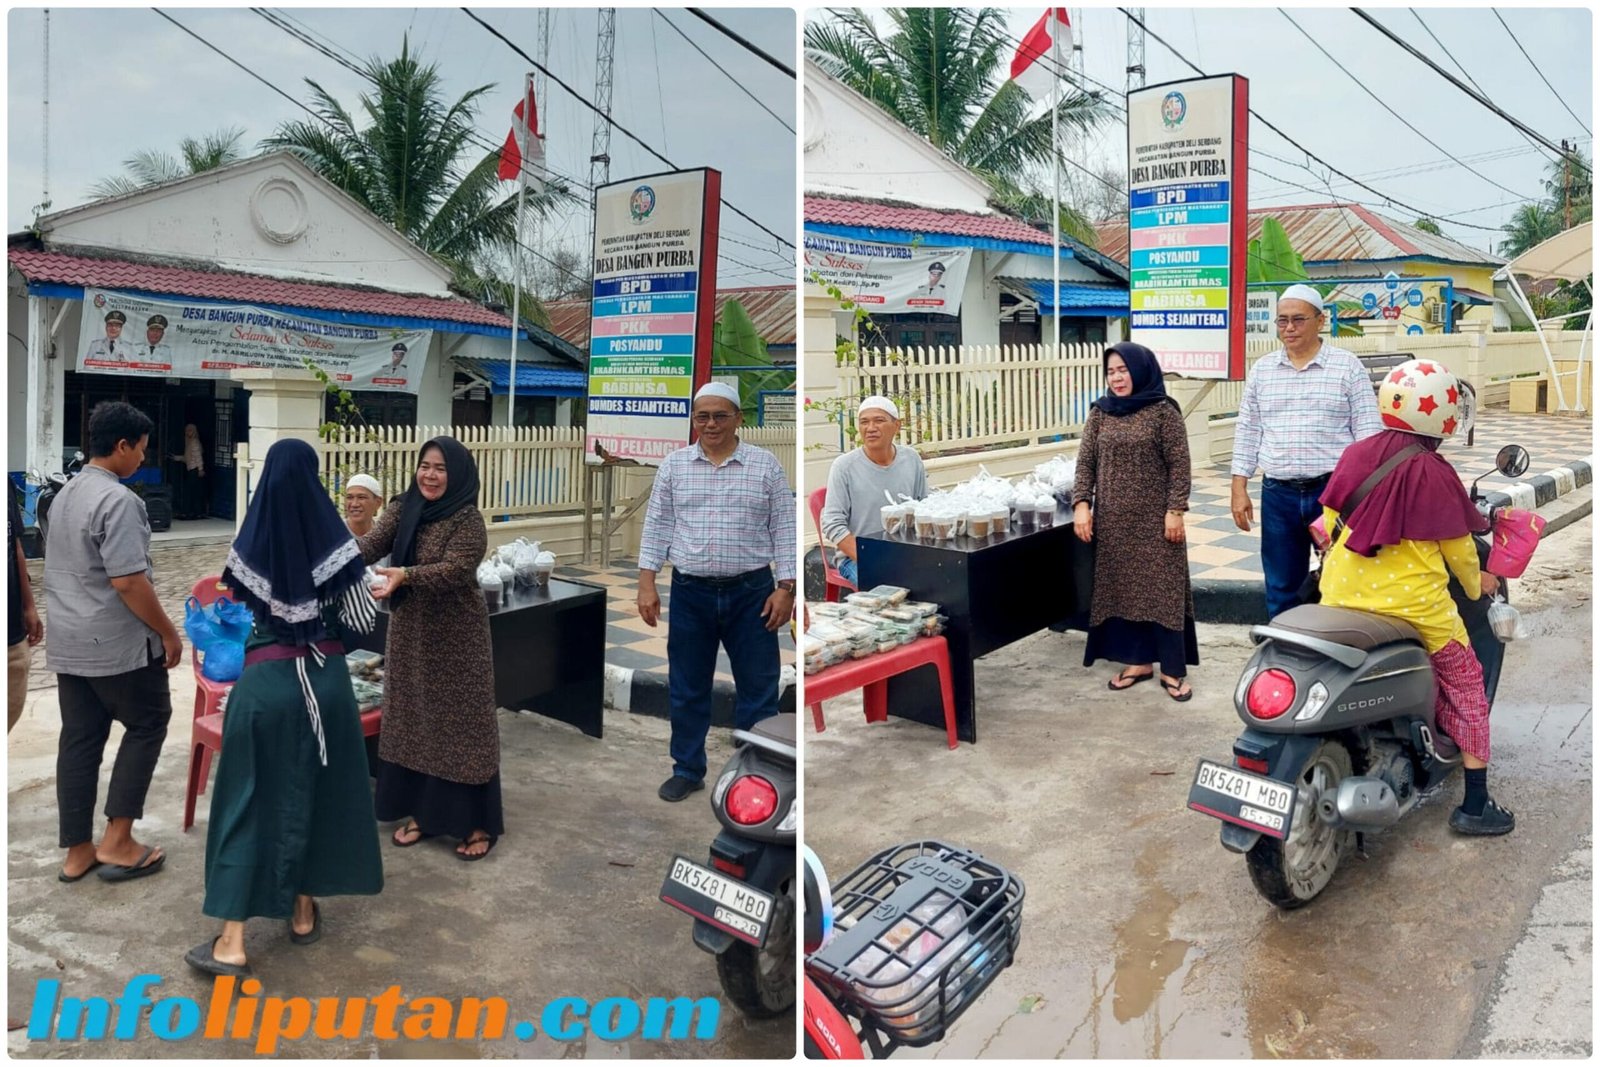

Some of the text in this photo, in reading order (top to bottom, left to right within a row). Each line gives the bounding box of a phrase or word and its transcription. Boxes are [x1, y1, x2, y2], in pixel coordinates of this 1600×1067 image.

[1186, 138, 1197, 147] DELI
[1197, 137, 1222, 146] SERDANG
[1169, 150, 1194, 159] BANGUN
[1132, 159, 1227, 184] DESA BANGUN PURBA
[1157, 190, 1187, 205] BPD
[1159, 211, 1188, 225] LPM
[653, 231, 665, 239] DELI
[666, 229, 691, 237] SERDANG
[1159, 232, 1187, 246] PKK
[604, 244, 634, 254] KECAMATAN
[635, 241, 661, 250] BANGUN
[849, 243, 885, 258] BANGUN
[886, 247, 913, 260] PURBA
[596, 250, 694, 274] DESA BANGUN PURBA
[819, 254, 864, 271] Sukses
[1149, 250, 1200, 265] POSYANDU
[840, 271, 854, 279] dan
[621, 279, 651, 293] BPD
[621, 301, 652, 314] LPM
[1144, 294, 1206, 307] BABINSA
[182, 307, 206, 320] DESA
[208, 309, 245, 324] BANGUN
[246, 313, 274, 327] PURBA
[275, 318, 323, 334] KECAMATAN
[355, 331, 379, 340] PURBA
[1133, 313, 1225, 326] BUMDES SEJAHTERA
[620, 321, 650, 334] PKK
[281, 332, 292, 345] &
[298, 334, 336, 350] Sukses
[610, 339, 662, 352] POSYANDU
[1163, 352, 1220, 368] PELANGI
[602, 382, 668, 394] BABINSA
[590, 399, 687, 414] BUMDES SEJAHTERA
[1338, 695, 1394, 712] SCOOPY
[1200, 767, 1288, 810] BK5481 MBO
[909, 861, 967, 890] GODA
[673, 862, 766, 919] BK5481 MBO
[816, 1017, 842, 1057] GODA
